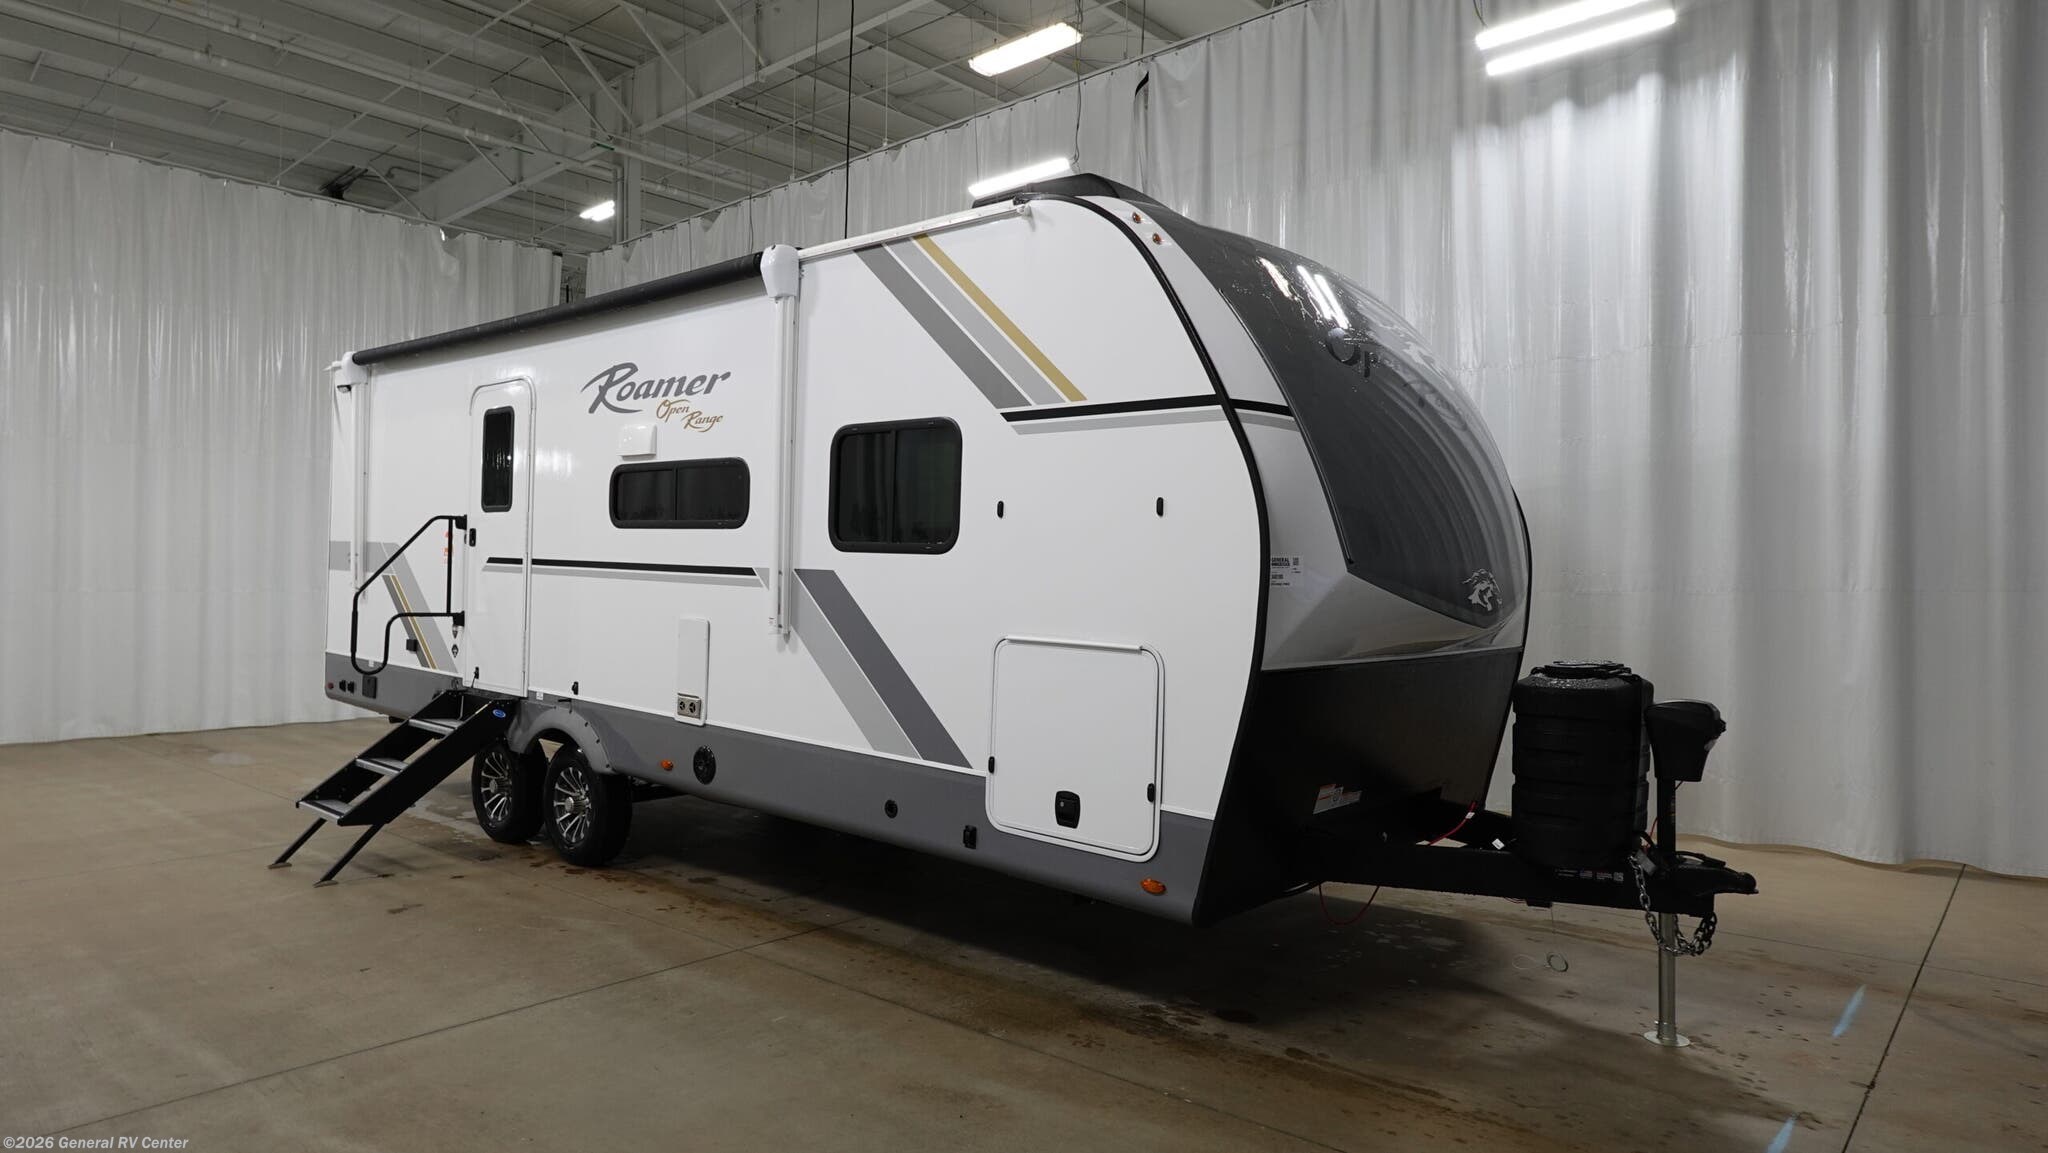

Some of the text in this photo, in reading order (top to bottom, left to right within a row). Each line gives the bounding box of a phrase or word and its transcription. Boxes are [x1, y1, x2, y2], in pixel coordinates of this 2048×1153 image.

[580, 362, 731, 414] Roamer
[656, 399, 691, 423] Open
[681, 410, 724, 432] Range
